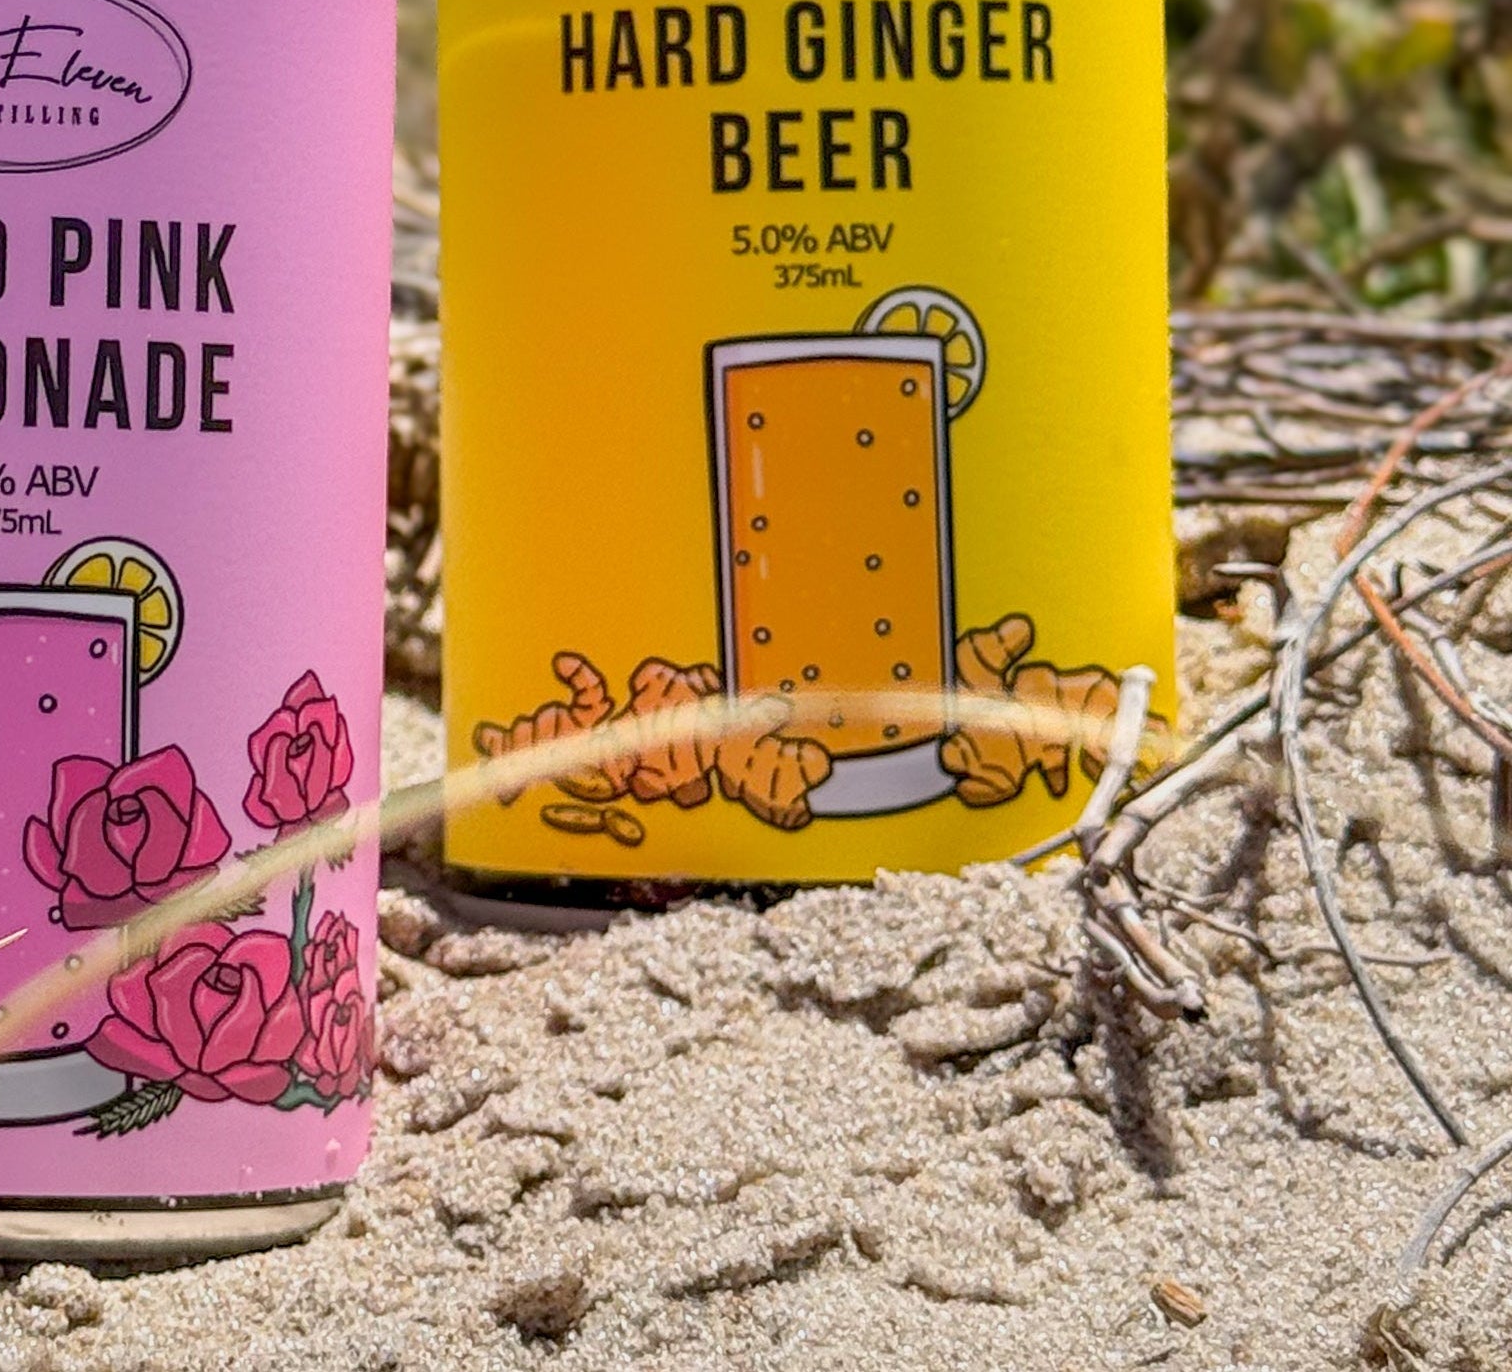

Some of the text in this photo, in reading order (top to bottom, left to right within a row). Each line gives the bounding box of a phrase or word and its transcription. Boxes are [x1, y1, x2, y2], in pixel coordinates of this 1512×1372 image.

[559, 0, 1055, 94] HARD GINGER
[711, 108, 914, 194] BEER
[49, 217, 237, 313] PINK
[731, 224, 894, 255] 5.0% ABV
[774, 264, 862, 289] 375mL
[25, 466, 100, 497] ABV
